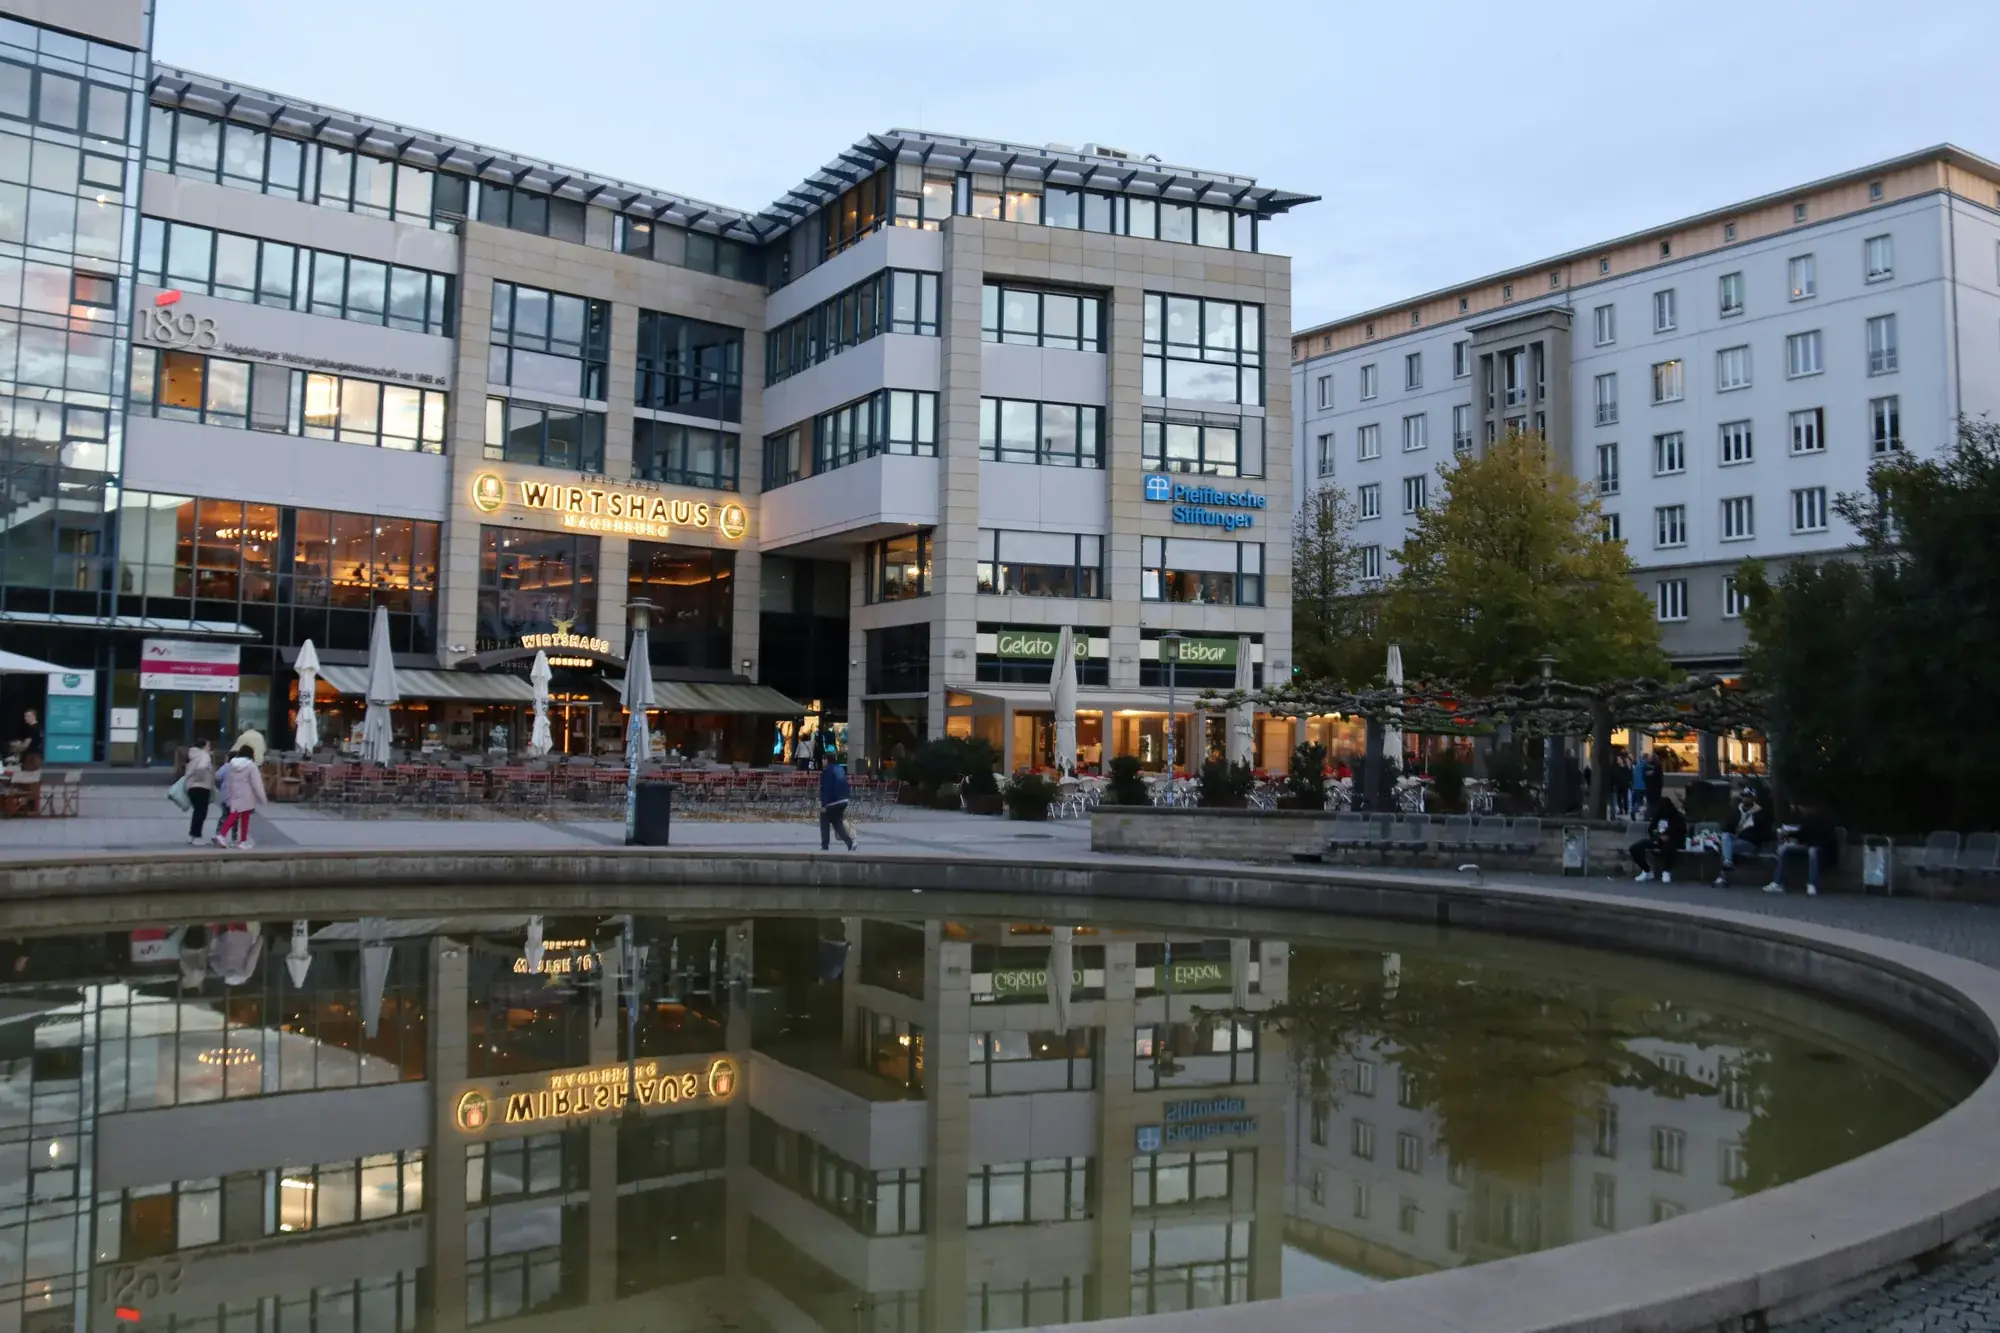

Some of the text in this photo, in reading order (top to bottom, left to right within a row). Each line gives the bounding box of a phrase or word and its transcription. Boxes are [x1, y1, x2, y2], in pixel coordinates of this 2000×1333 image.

[138, 307, 219, 349] 1893
[520, 480, 708, 528] WIRTSHAUS
[1173, 484, 1267, 508] Pfeiffersche
[563, 514, 669, 538] MAGDEBURG
[1172, 505, 1255, 531] Stiftungen
[520, 632, 610, 653] WIRTSHAUS
[1000, 635, 1053, 655] Gelato
[1179, 641, 1227, 660] Eisbar
